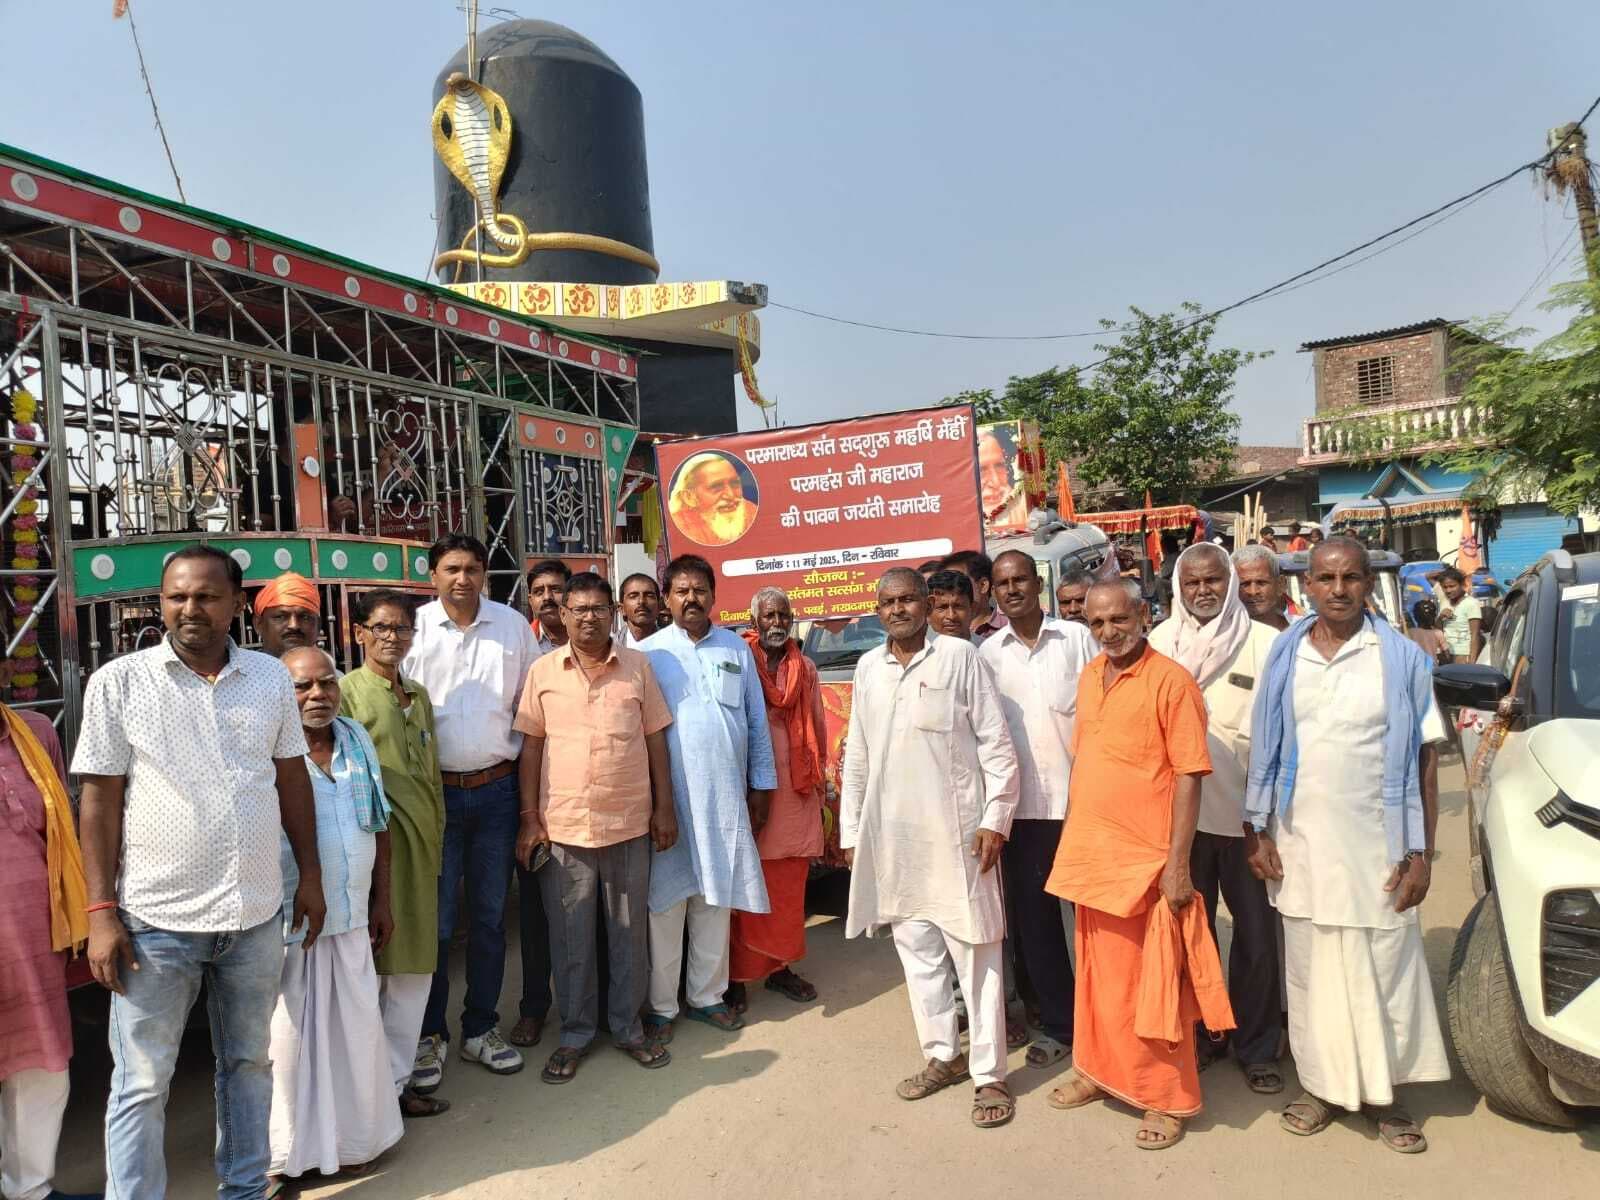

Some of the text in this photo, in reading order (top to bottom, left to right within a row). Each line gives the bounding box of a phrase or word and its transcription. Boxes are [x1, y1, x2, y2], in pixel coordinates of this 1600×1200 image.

[745, 442, 808, 464] परमाराध्य
[811, 433, 835, 457] संत
[894, 418, 933, 446] महर्षि
[789, 462, 924, 493] परमहंस जी महाराज
[780, 491, 941, 529] की पावन जयंती समारोह
[756, 558, 784, 572] दिनांक
[793, 559, 800, 568] 11
[803, 554, 817, 567] मई
[842, 550, 859, 563] दिन
[869, 547, 900, 560] रविवार
[786, 586, 824, 600] संतमत
[826, 581, 864, 597] सत्संग
